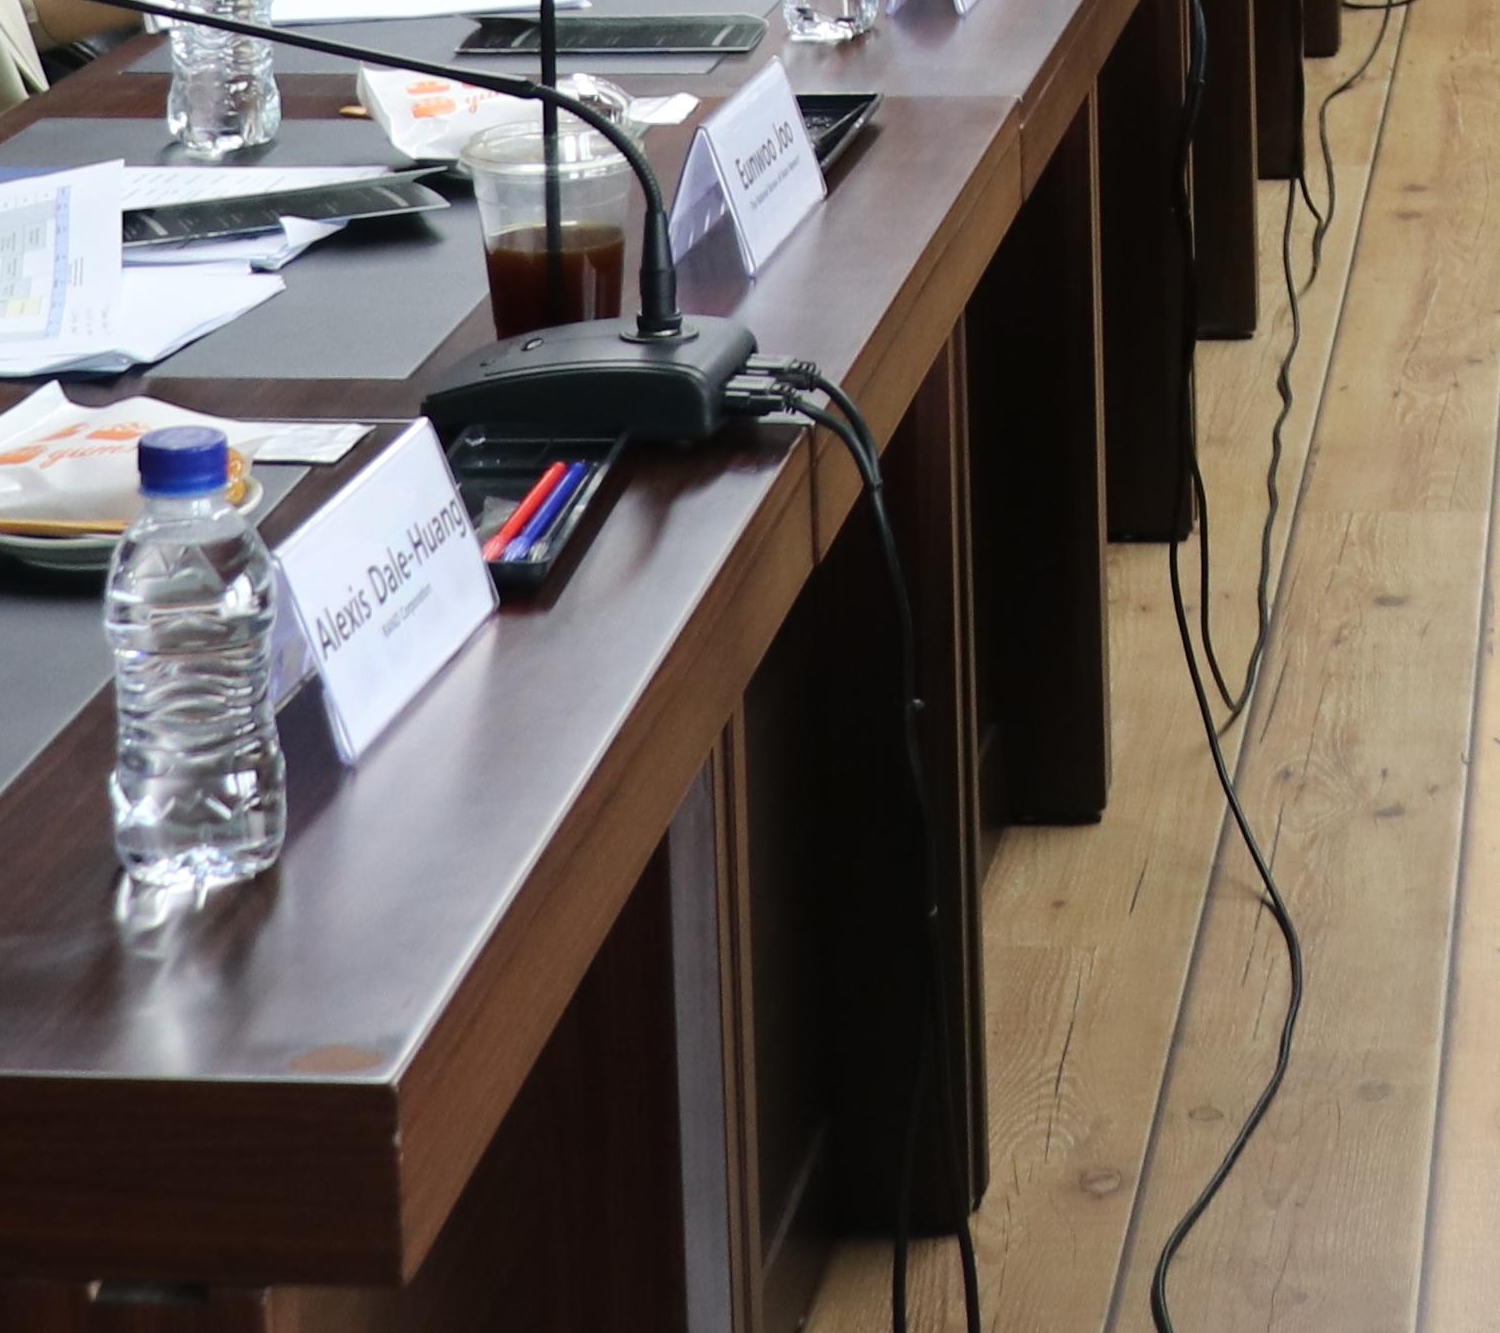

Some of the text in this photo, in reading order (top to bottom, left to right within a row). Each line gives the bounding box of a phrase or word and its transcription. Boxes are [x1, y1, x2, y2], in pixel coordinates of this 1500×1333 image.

[734, 137, 778, 191] Eunwoo
[771, 120, 795, 155] Joo
[315, 498, 467, 661] Alexis Dale-Huang
